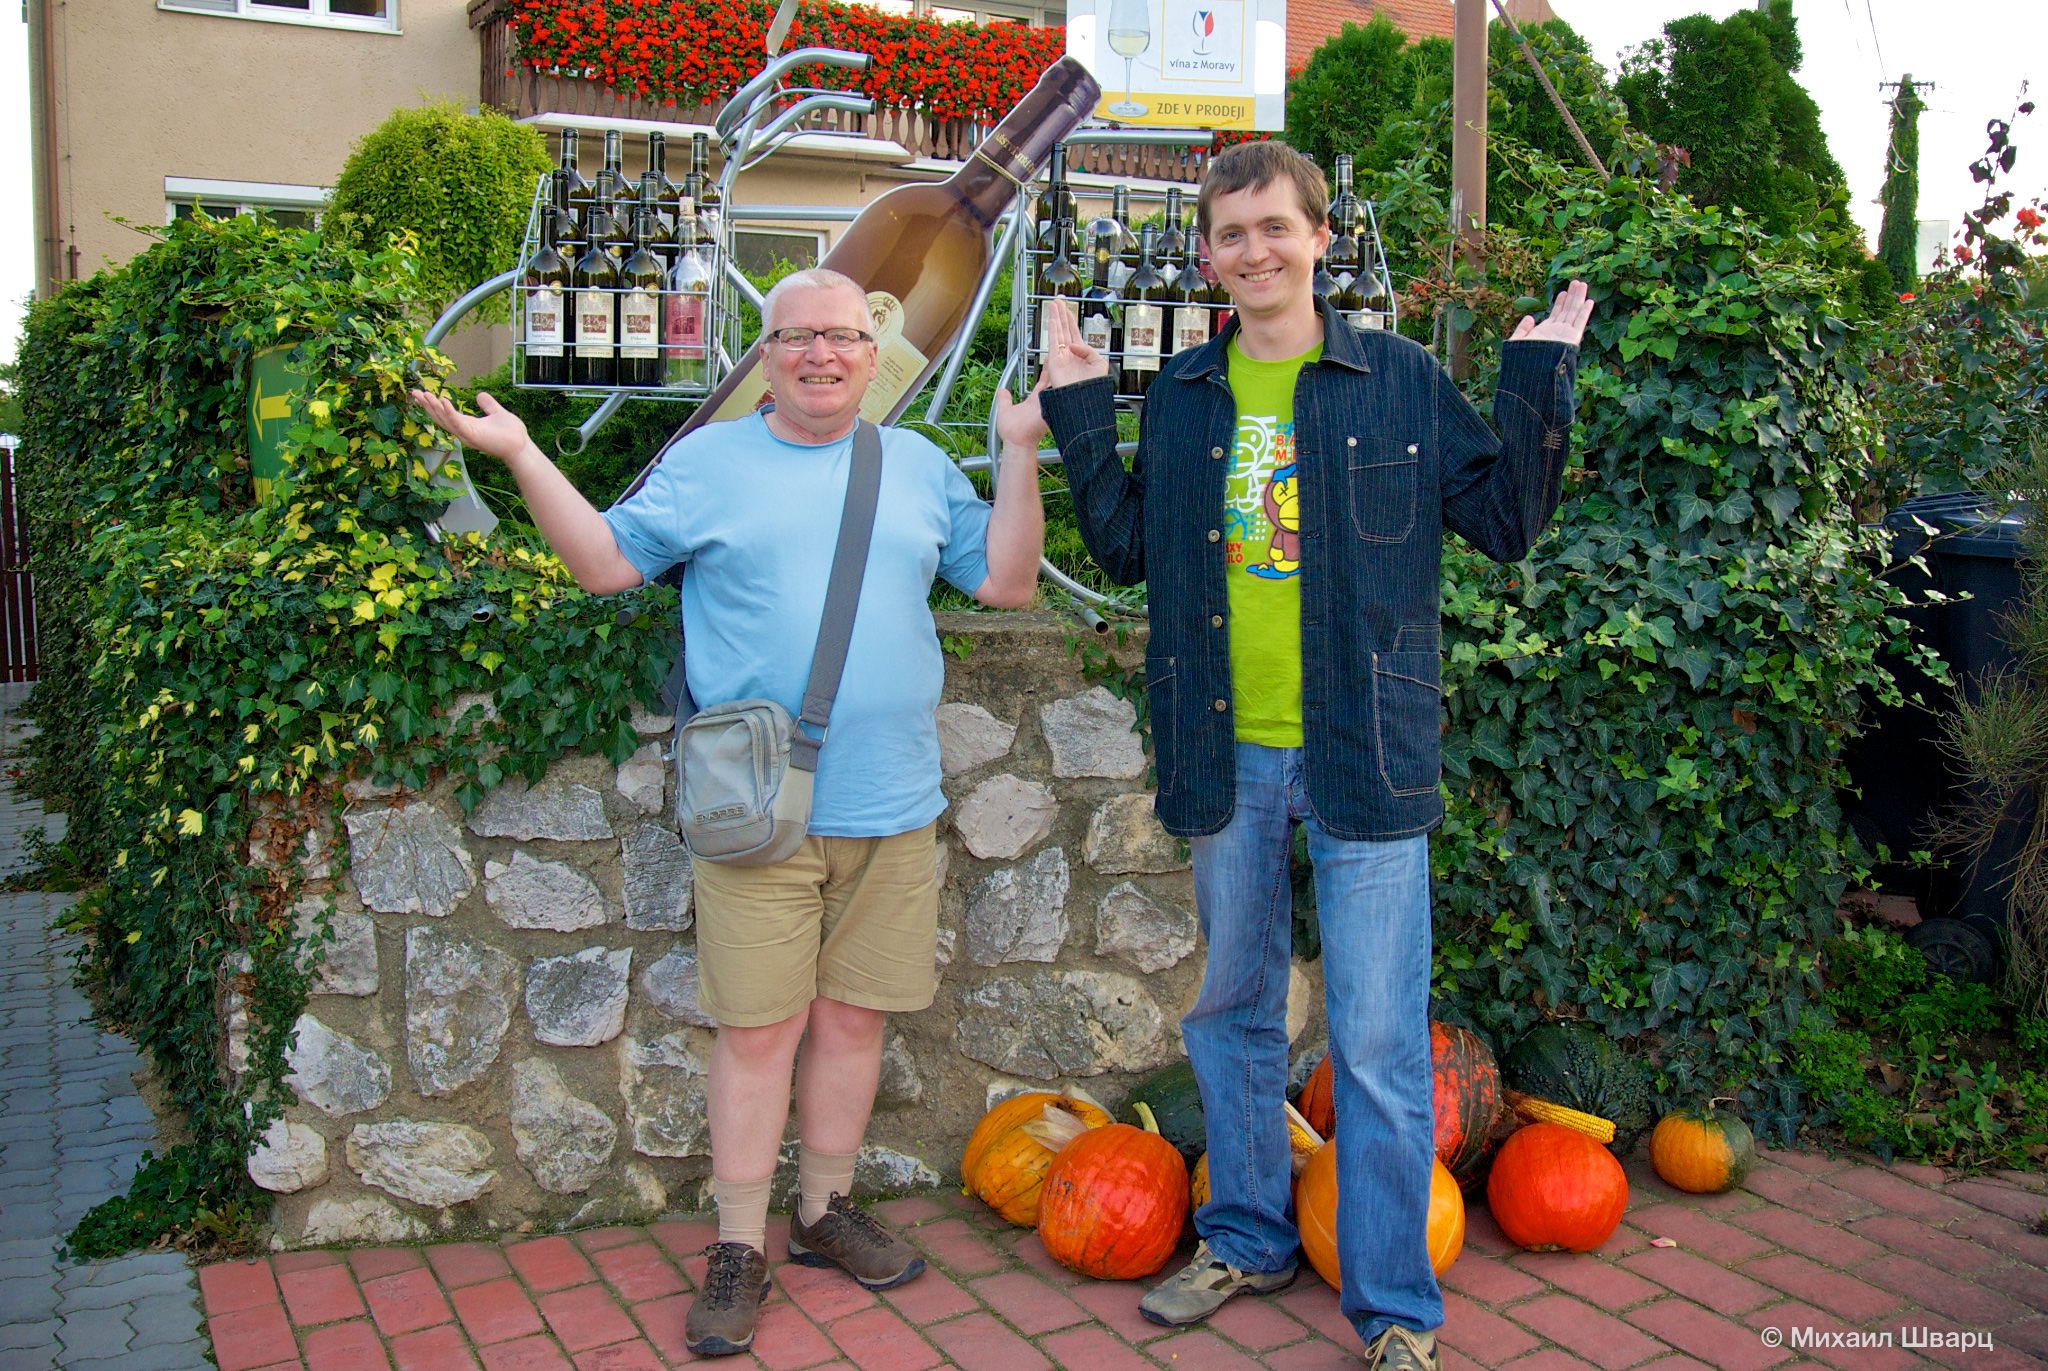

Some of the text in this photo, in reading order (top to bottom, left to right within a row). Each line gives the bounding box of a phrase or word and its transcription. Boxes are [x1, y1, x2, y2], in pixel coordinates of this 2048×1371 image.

[1170, 59, 1191, 69] vína
[1200, 60, 1235, 72] Moravy
[1157, 102, 1245, 119] ZDE V PRODEJI
[1227, 553, 1243, 564] ILO
